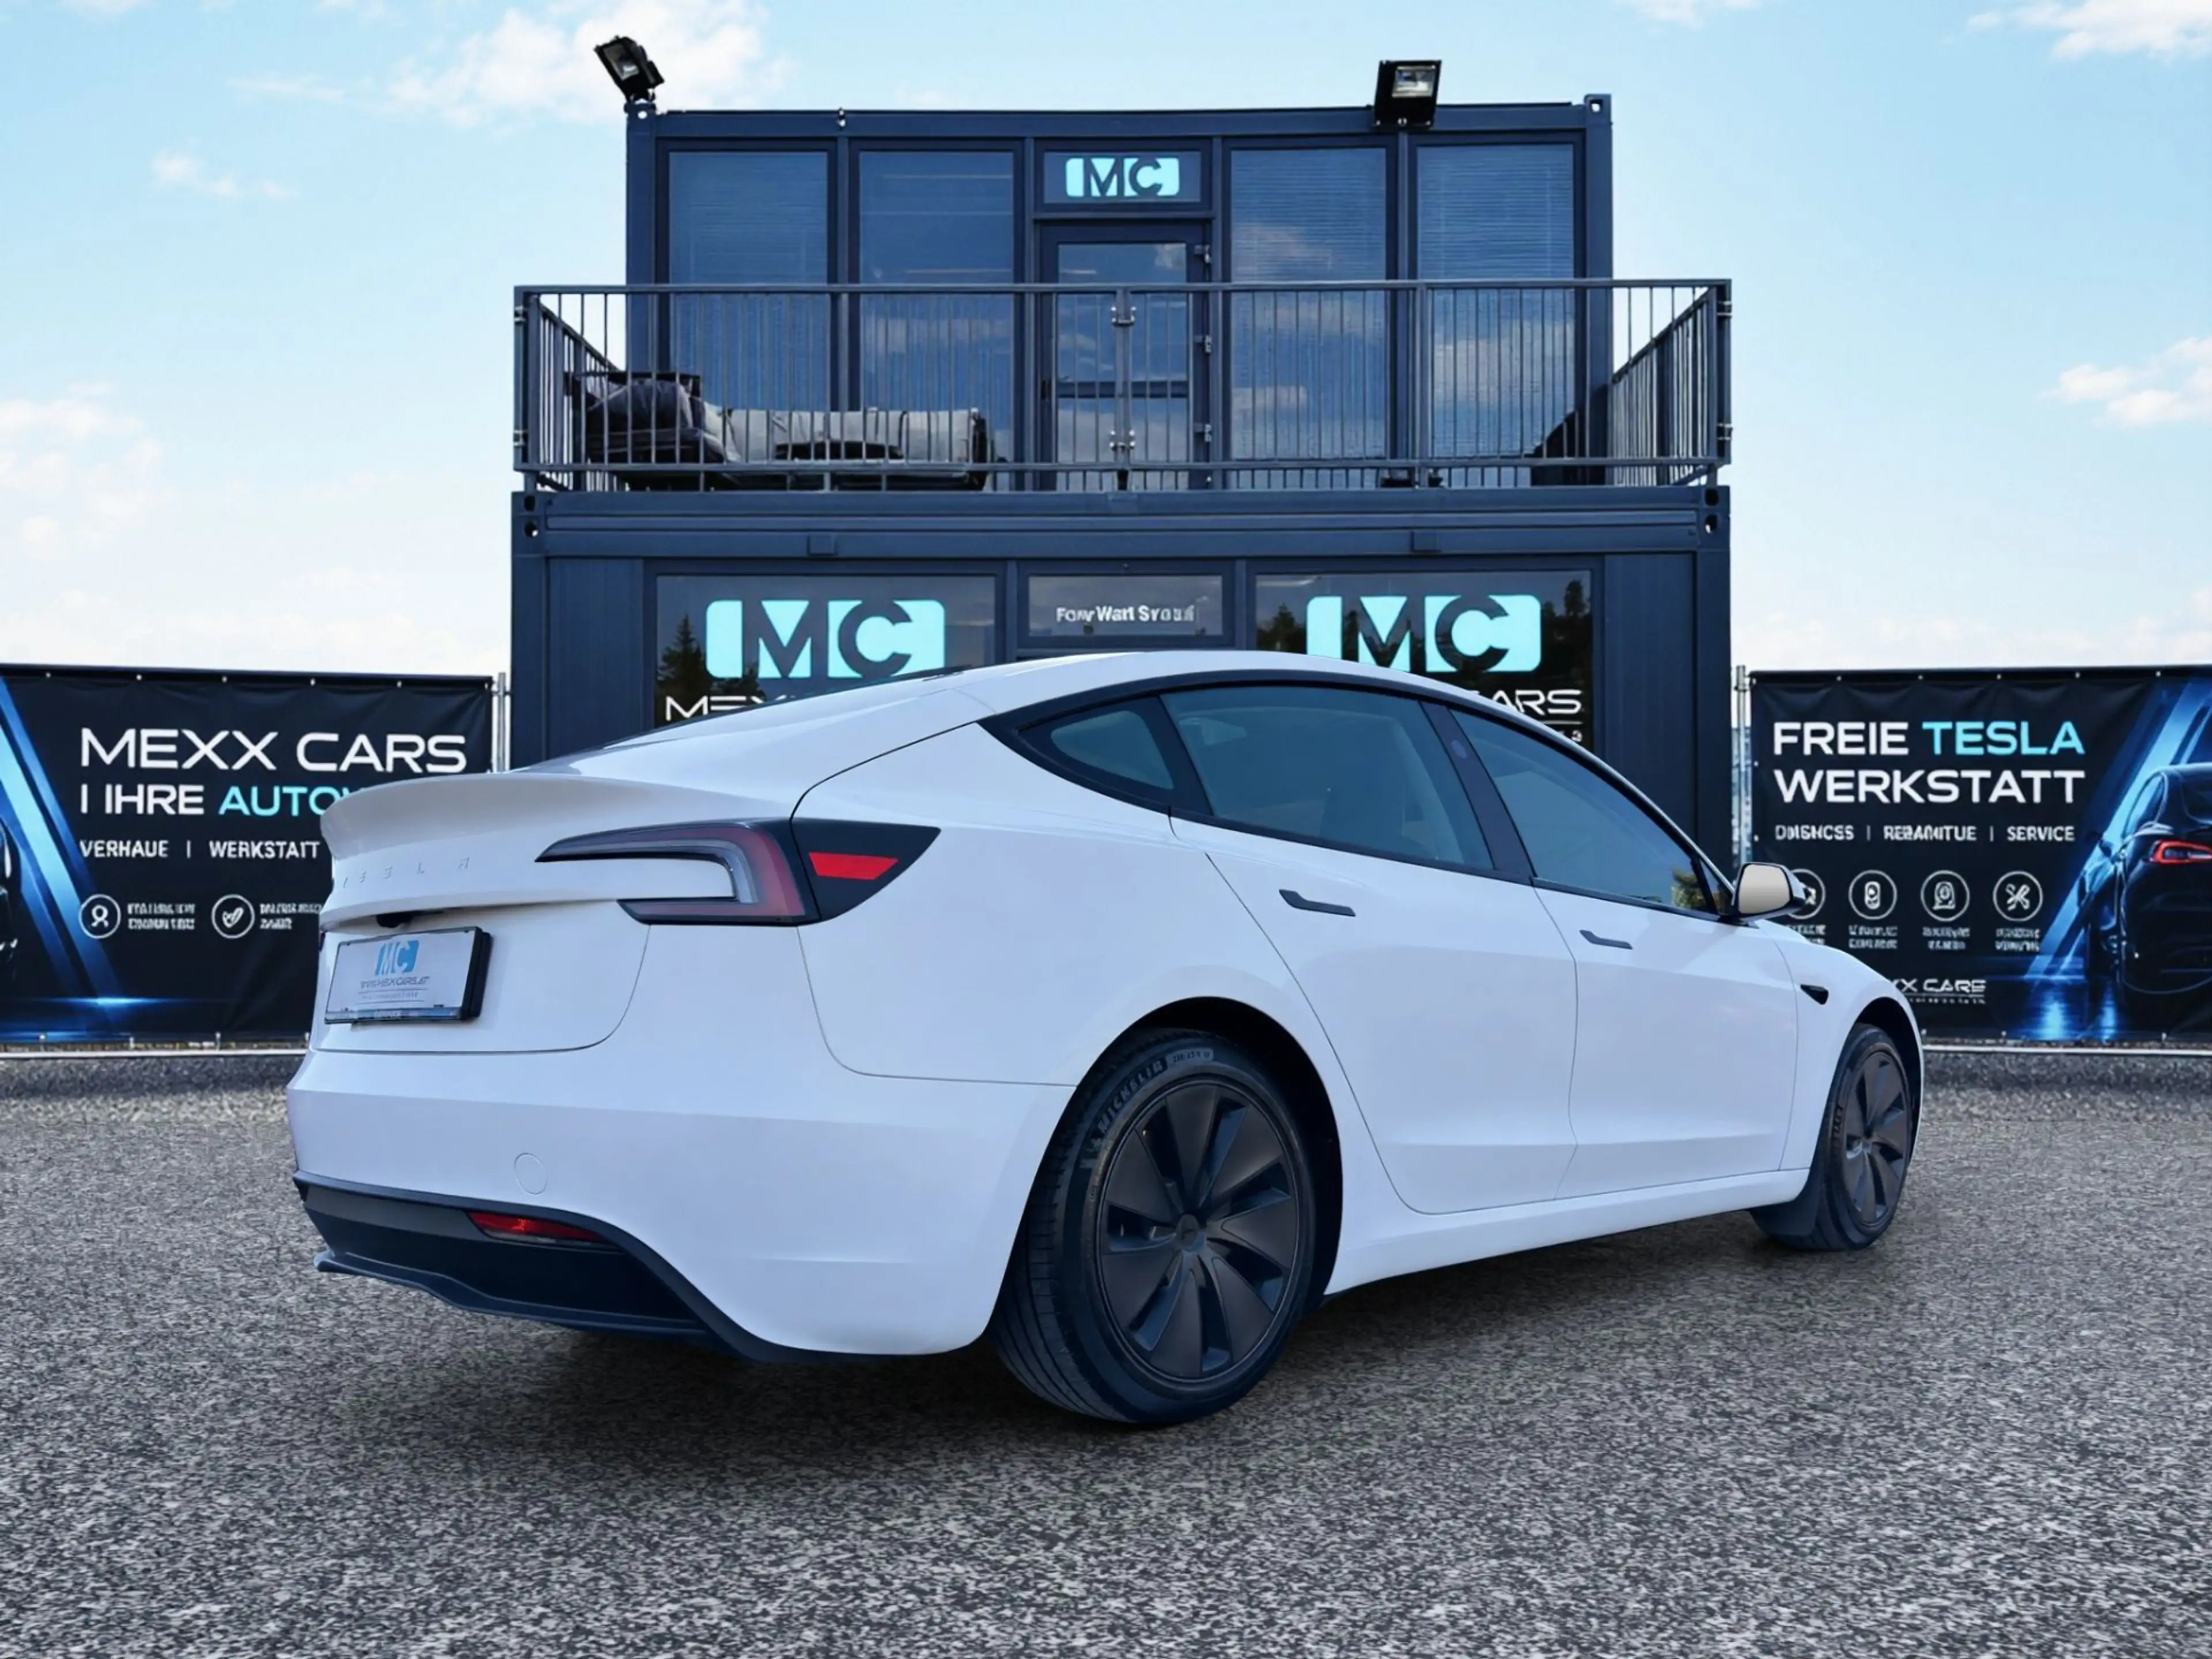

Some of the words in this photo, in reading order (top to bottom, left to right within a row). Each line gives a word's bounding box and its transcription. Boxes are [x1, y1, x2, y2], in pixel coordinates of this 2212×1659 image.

[1082, 157, 1163, 197] MC
[740, 599, 913, 679] MC
[1339, 594, 1509, 672] MC
[81, 728, 278, 770] MEXX
[297, 732, 467, 773] CARS
[1774, 722, 1909, 755] FREIE
[1922, 721, 2085, 755] TESLA
[105, 784, 204, 815] IHRE
[218, 786, 349, 817] AUTO
[1774, 769, 2085, 804] WERKSTATT
[2007, 825, 2075, 842] SERVICE
